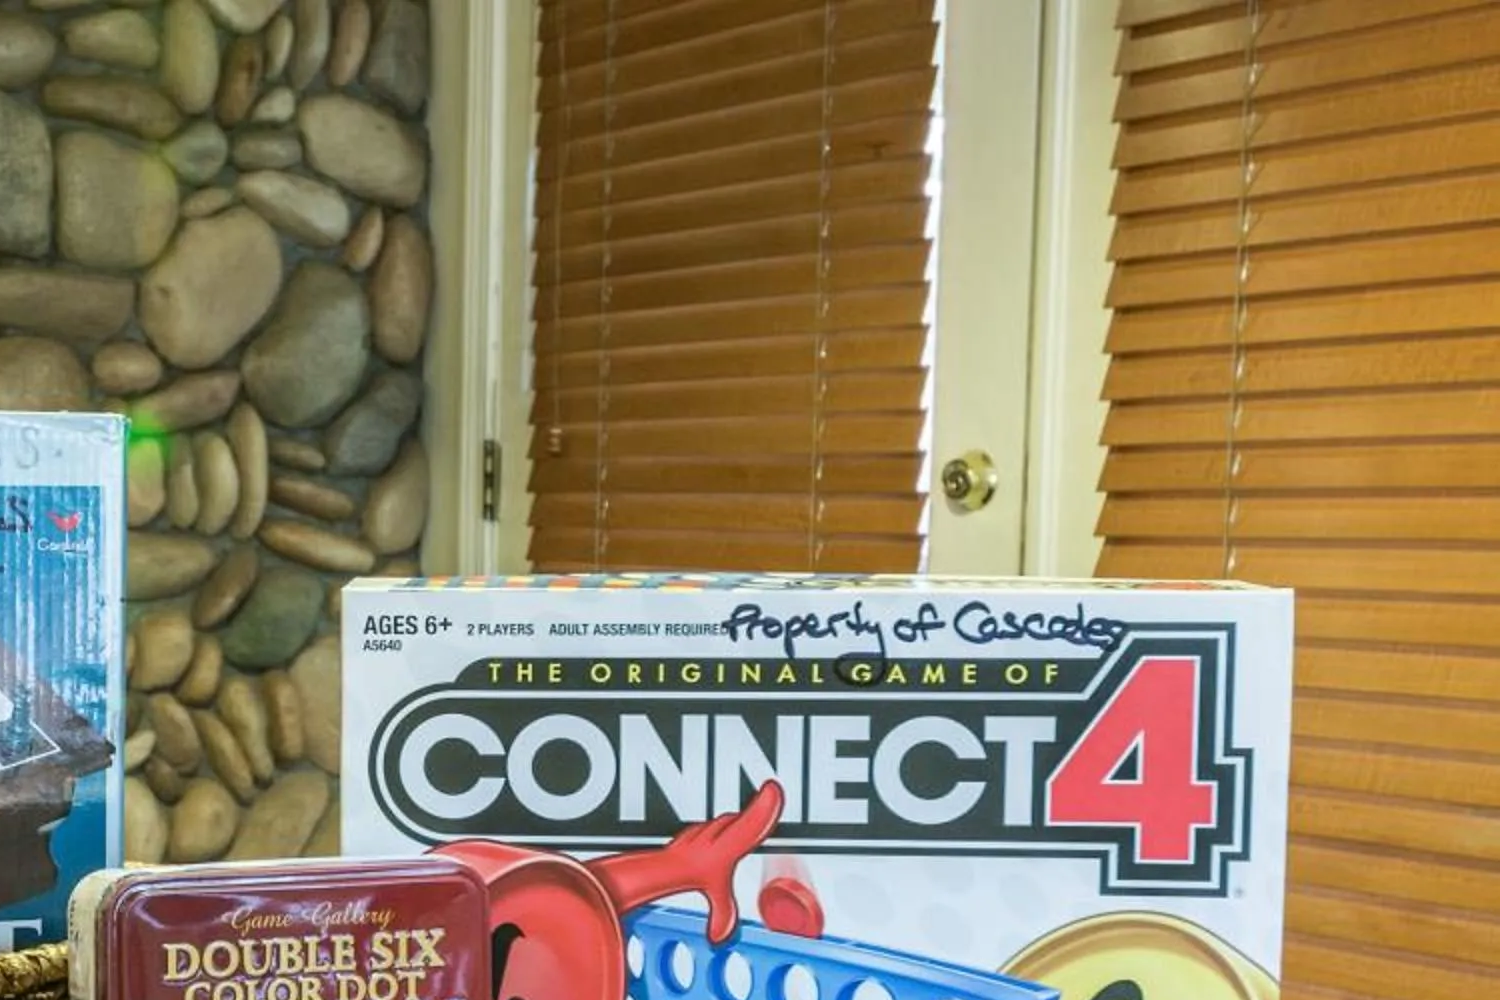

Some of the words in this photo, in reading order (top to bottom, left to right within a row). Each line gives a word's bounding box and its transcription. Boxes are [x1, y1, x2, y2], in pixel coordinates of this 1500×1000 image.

[363, 615, 417, 635] AGES
[424, 615, 453, 635] 6+
[467, 623, 476, 636] 2
[477, 623, 534, 636] PLAYERS
[549, 624, 588, 636] ADULT
[592, 623, 661, 636] ASSEMBLY
[664, 623, 728, 636] REQUIRED
[363, 639, 403, 652] A5640
[722, 601, 887, 687] Property
[893, 603, 946, 643] of
[487, 662, 563, 684] THE
[589, 662, 825, 685] ORIGINAL
[850, 662, 979, 685] GAME
[1004, 662, 1059, 685] OF
[399, 712, 1057, 827] CONNECT
[1043, 653, 1219, 865] 4
[222, 908, 294, 936] Game
[300, 900, 397, 932] Gallery
[161, 933, 356, 984] DOUBLE
[369, 927, 447, 970] SIX
